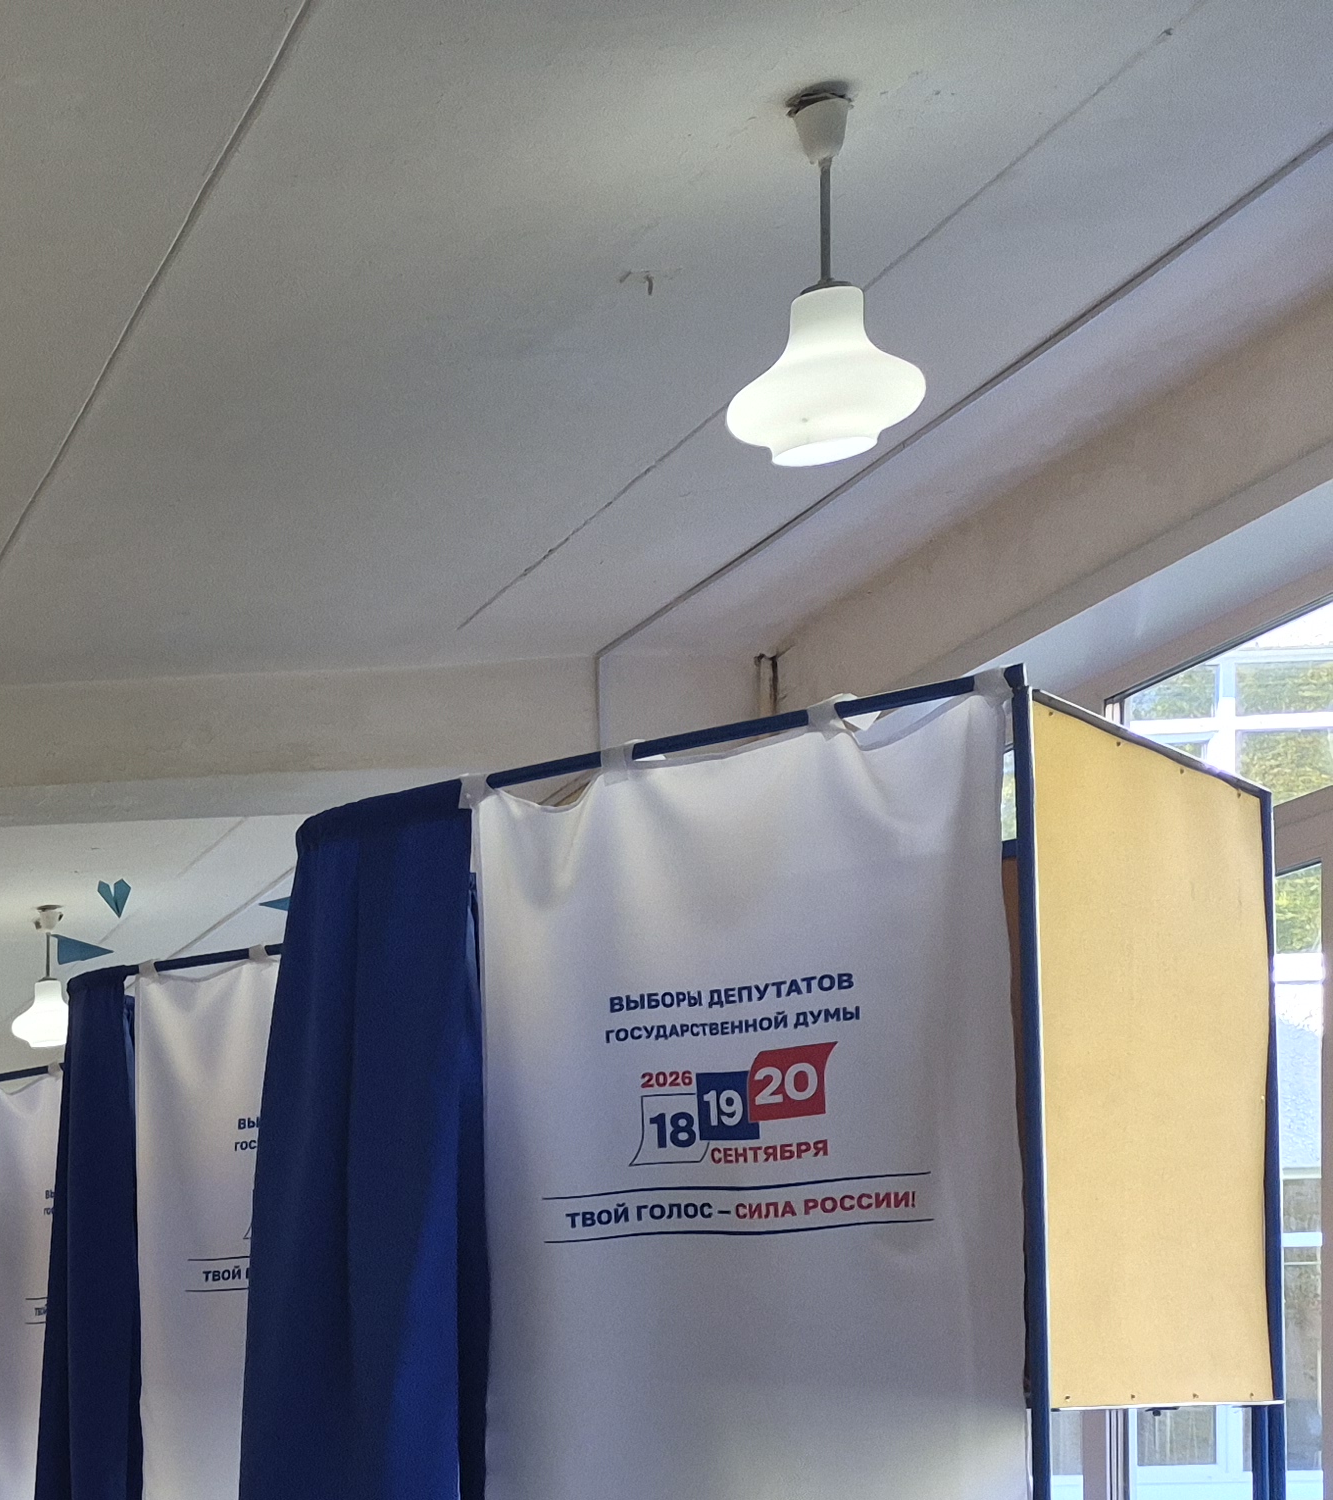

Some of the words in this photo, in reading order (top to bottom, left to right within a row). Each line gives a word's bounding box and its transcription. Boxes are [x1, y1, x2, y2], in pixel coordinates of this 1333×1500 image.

[609, 990, 703, 1013] ВЫБОРЫ
[708, 972, 854, 1009] ДЕПУТАТОВ
[605, 1011, 788, 1043] ГОСУДАРСТВЕННОЙ
[793, 1005, 861, 1029] ДУМЫ
[640, 1070, 693, 1088] 2026
[649, 1111, 697, 1149] 18
[703, 1089, 744, 1126] 19
[754, 1062, 818, 1106] 20
[711, 1139, 829, 1164] СЕНТЯБРЯ
[566, 1202, 630, 1229] ТВОЙ
[636, 1202, 713, 1222] ГОЛОС
[735, 1200, 797, 1220] СИЛА
[803, 1190, 916, 1216] РОССИИ!
[202, 1265, 242, 1283] ТВОЙ
